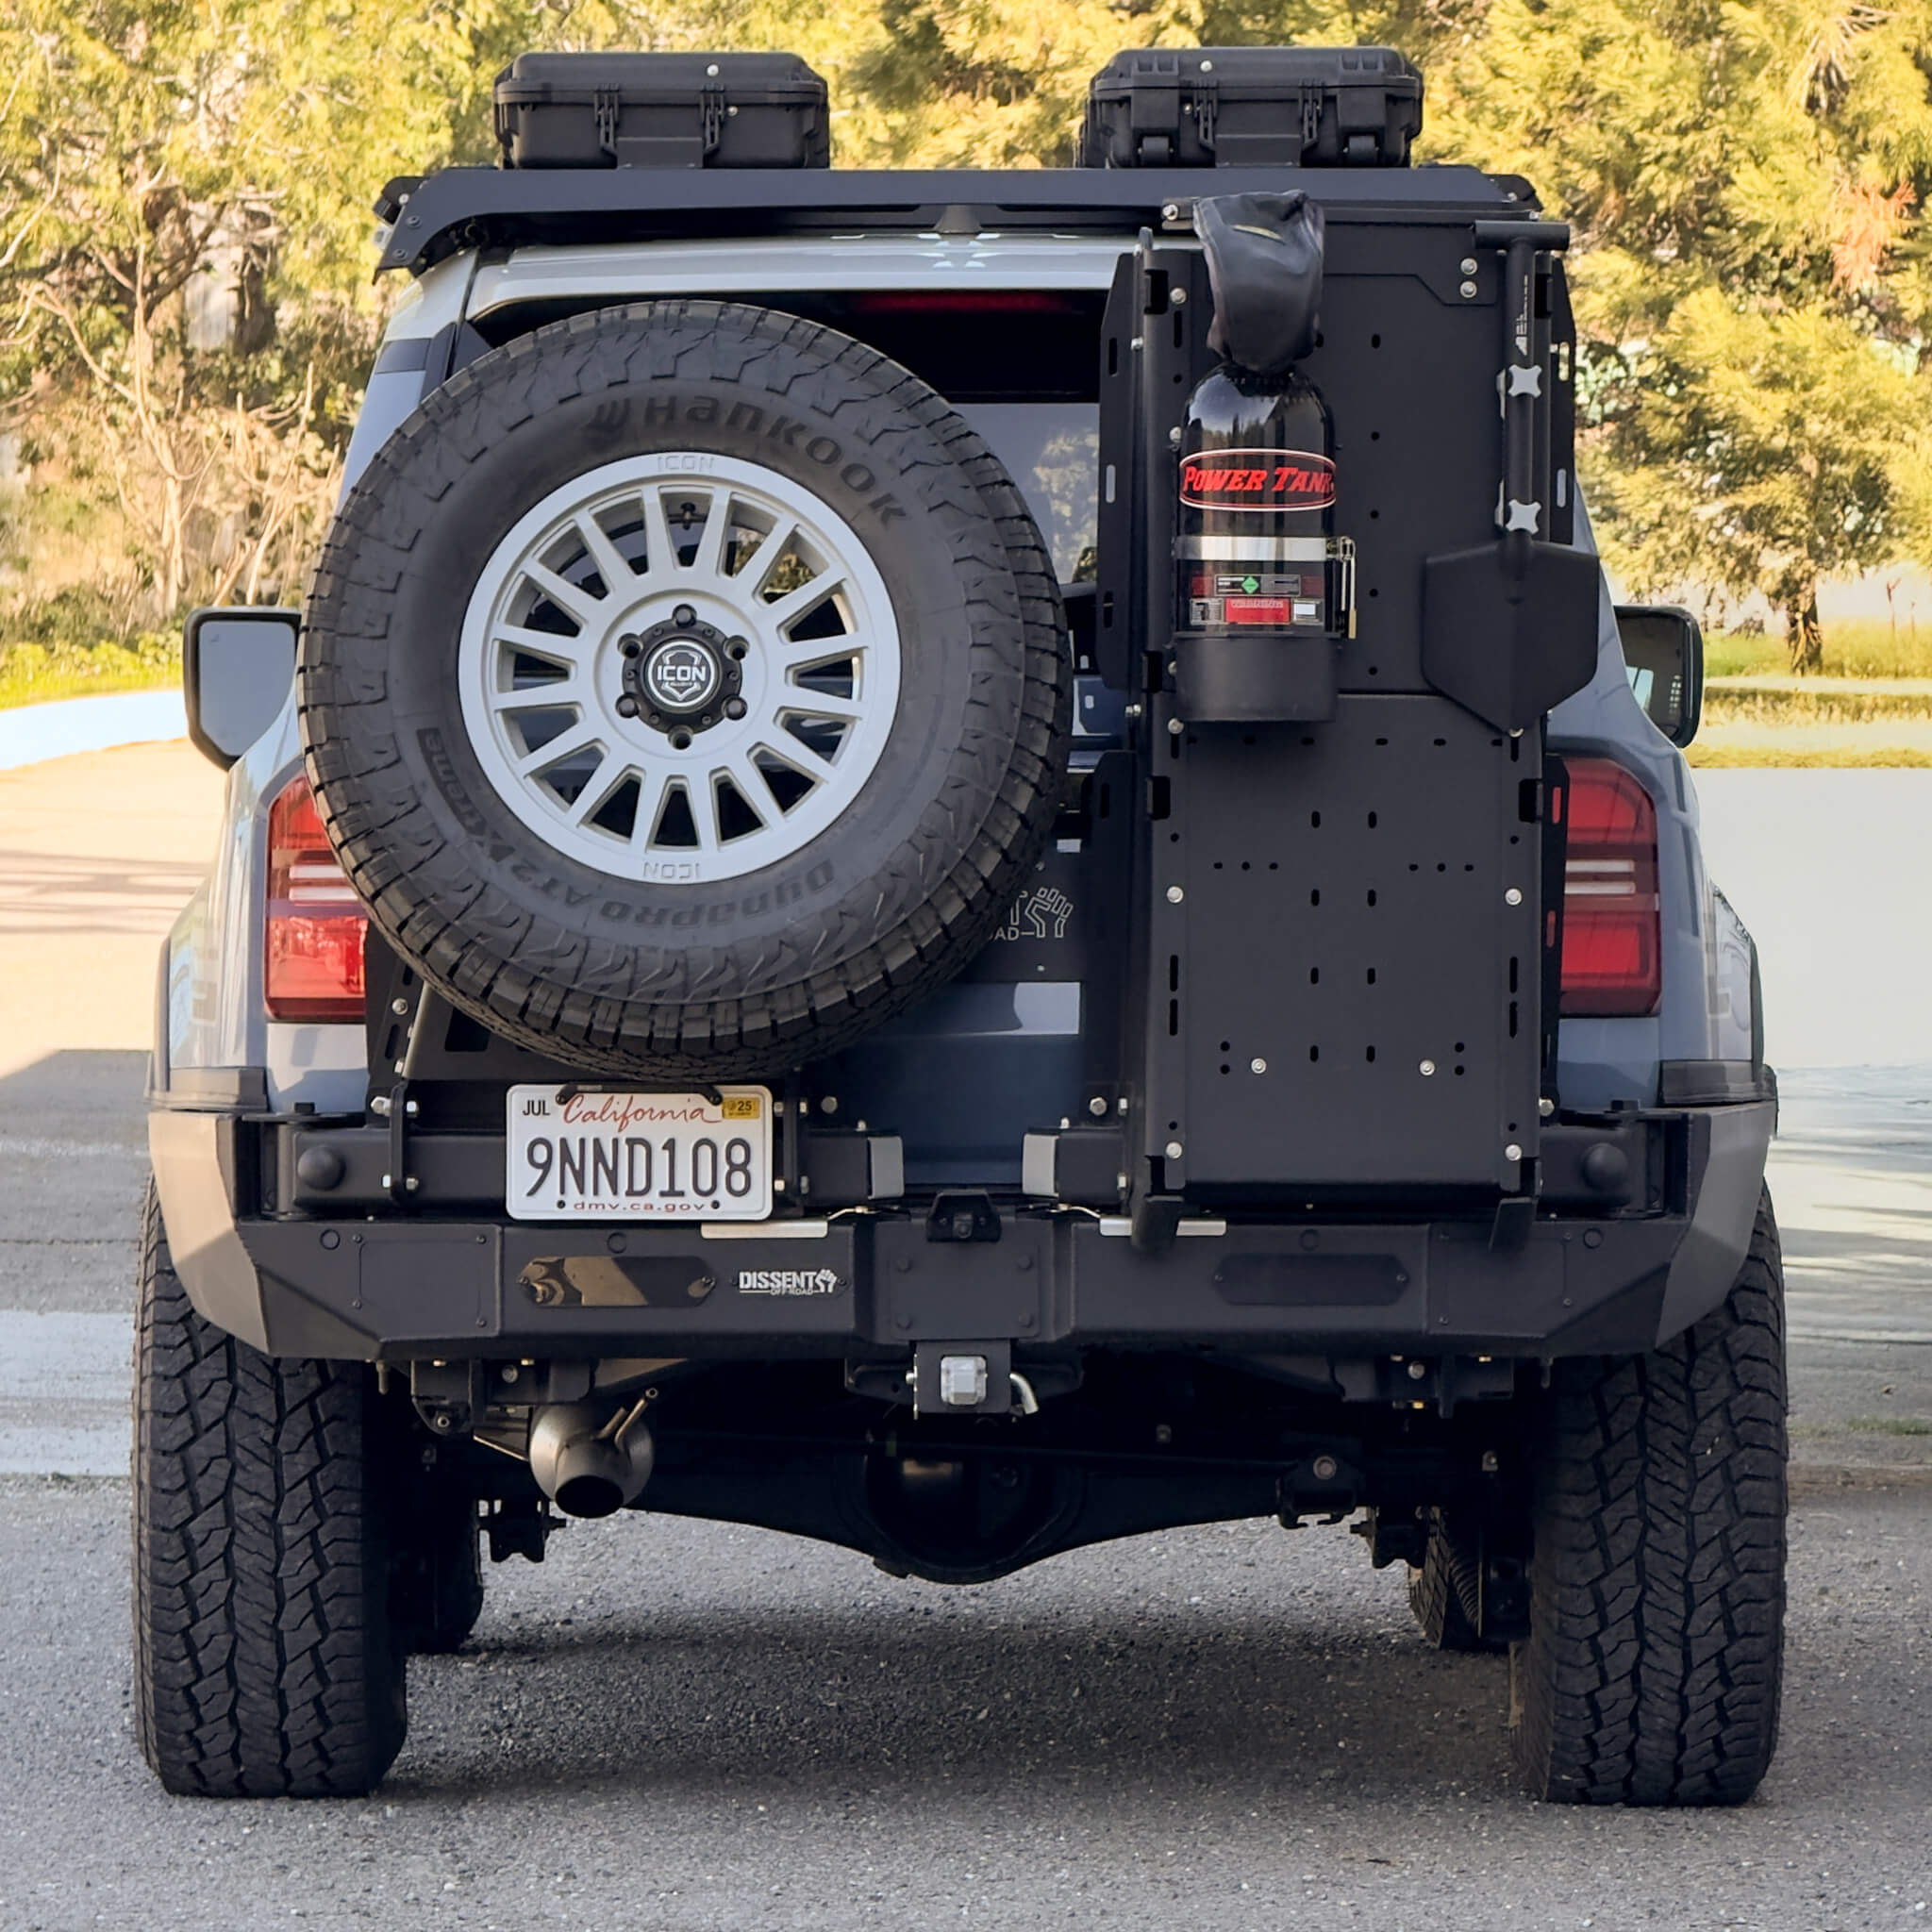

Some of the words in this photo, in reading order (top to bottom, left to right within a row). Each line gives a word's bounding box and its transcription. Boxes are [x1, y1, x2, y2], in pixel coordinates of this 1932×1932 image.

[658, 456, 715, 472] ICON
[657, 665, 707, 681] ICON
[642, 861, 700, 879] ICON
[523, 1100, 549, 1116] JUL
[562, 1093, 723, 1132] California
[738, 1100, 753, 1111] 25
[526, 1138, 752, 1197] 9NND108
[574, 1201, 705, 1212] dmv.ca.gov
[739, 1271, 818, 1290] DISSENT
